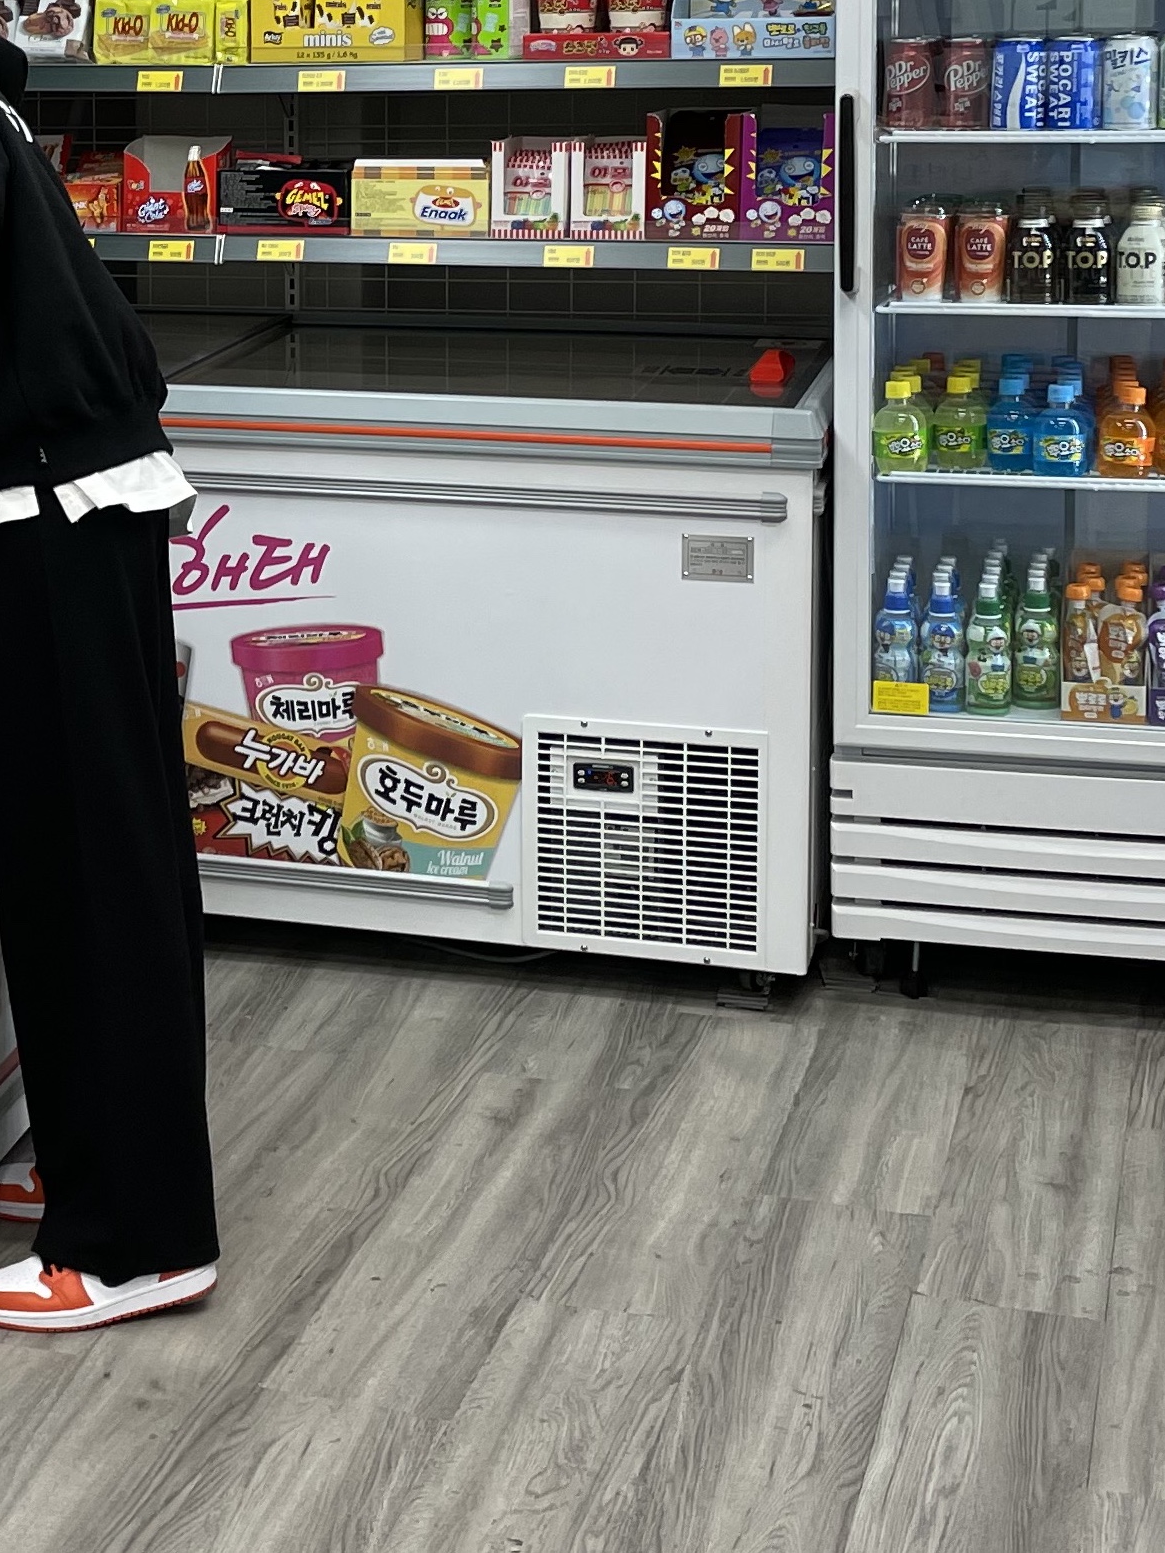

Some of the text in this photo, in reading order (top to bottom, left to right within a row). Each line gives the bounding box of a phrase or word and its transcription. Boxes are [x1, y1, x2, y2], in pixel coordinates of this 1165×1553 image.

[112, 14, 144, 37] Kid-O
[166, 11, 199, 34] Kid-O
[302, 30, 353, 48] minis
[296, 50, 305, 59] 12
[1104, 47, 1152, 70] 밀키스
[946, 66, 987, 92] Peppe
[1024, 51, 1037, 127] SWEAT
[1057, 50, 1072, 128] POCARI
[286, 189, 329, 211] GEMEZ
[420, 205, 468, 222] Enaak
[907, 242, 933, 252] LATTE
[967, 243, 993, 253] LATTE
[1011, 250, 1055, 269] T.O.P
[1066, 250, 1108, 269] T.O.P
[1117, 250, 1158, 270] T.O.P
[171, 504, 331, 596] 해태
[233, 728, 326, 785] 누가바
[374, 764, 478, 833] 호두마루
[436, 847, 485, 867] Walnut
[426, 860, 469, 876] Ice cream
